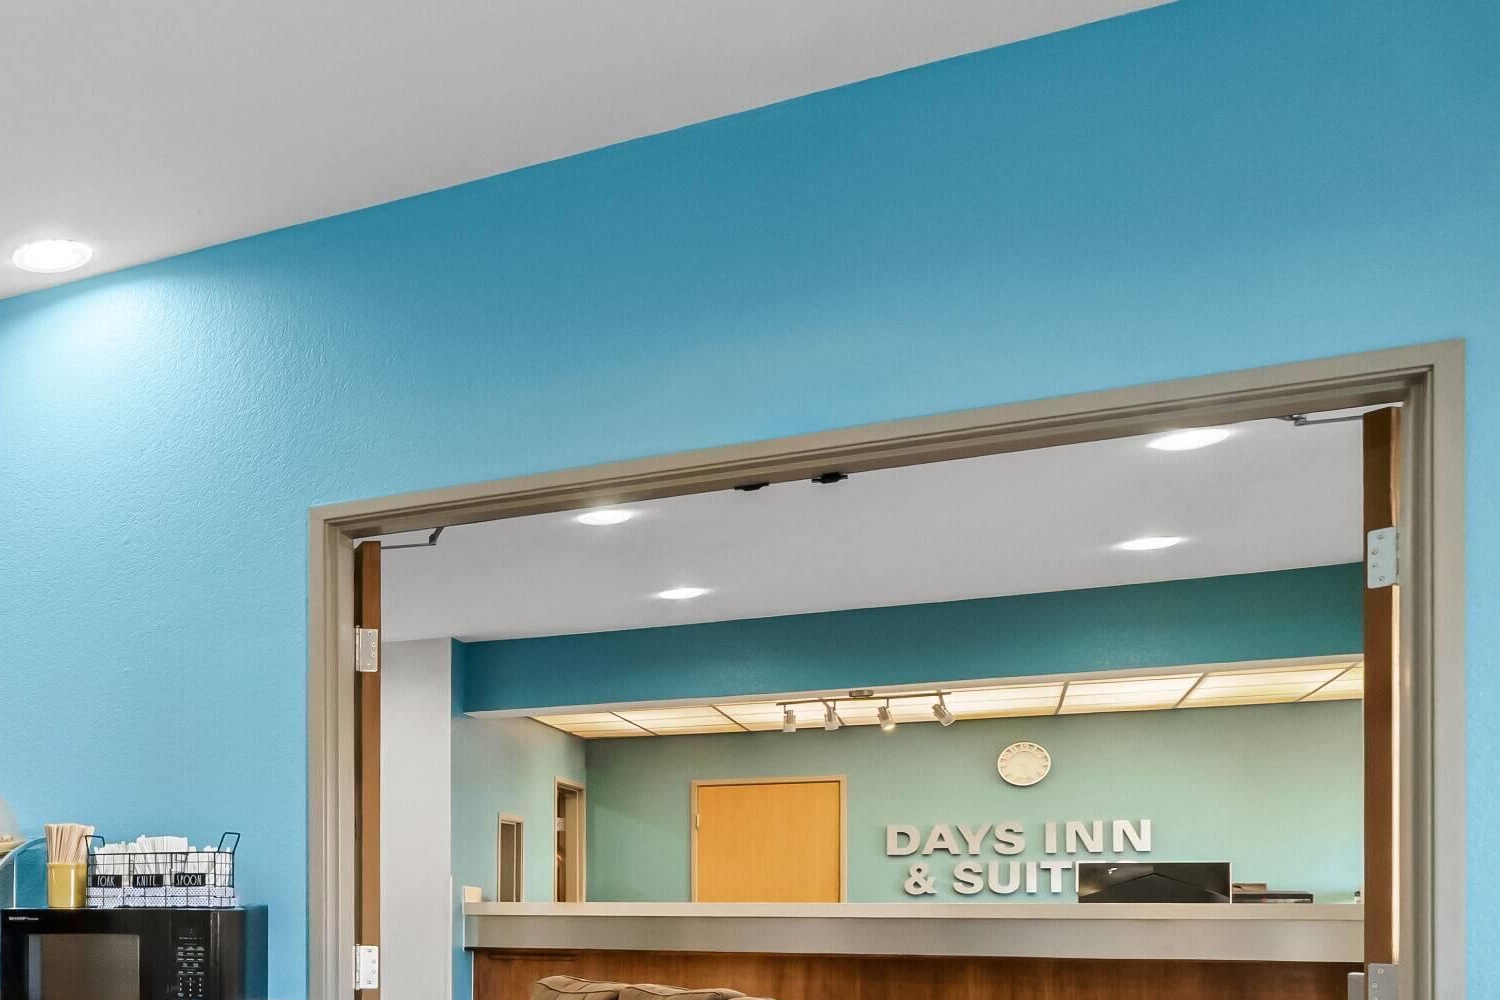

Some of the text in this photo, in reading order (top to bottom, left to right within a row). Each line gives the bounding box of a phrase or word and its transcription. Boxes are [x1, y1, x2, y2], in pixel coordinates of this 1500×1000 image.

[886, 819, 1151, 856] DAYS INN
[176, 874, 202, 885] SPOON
[904, 860, 1138, 896] & SUIT
